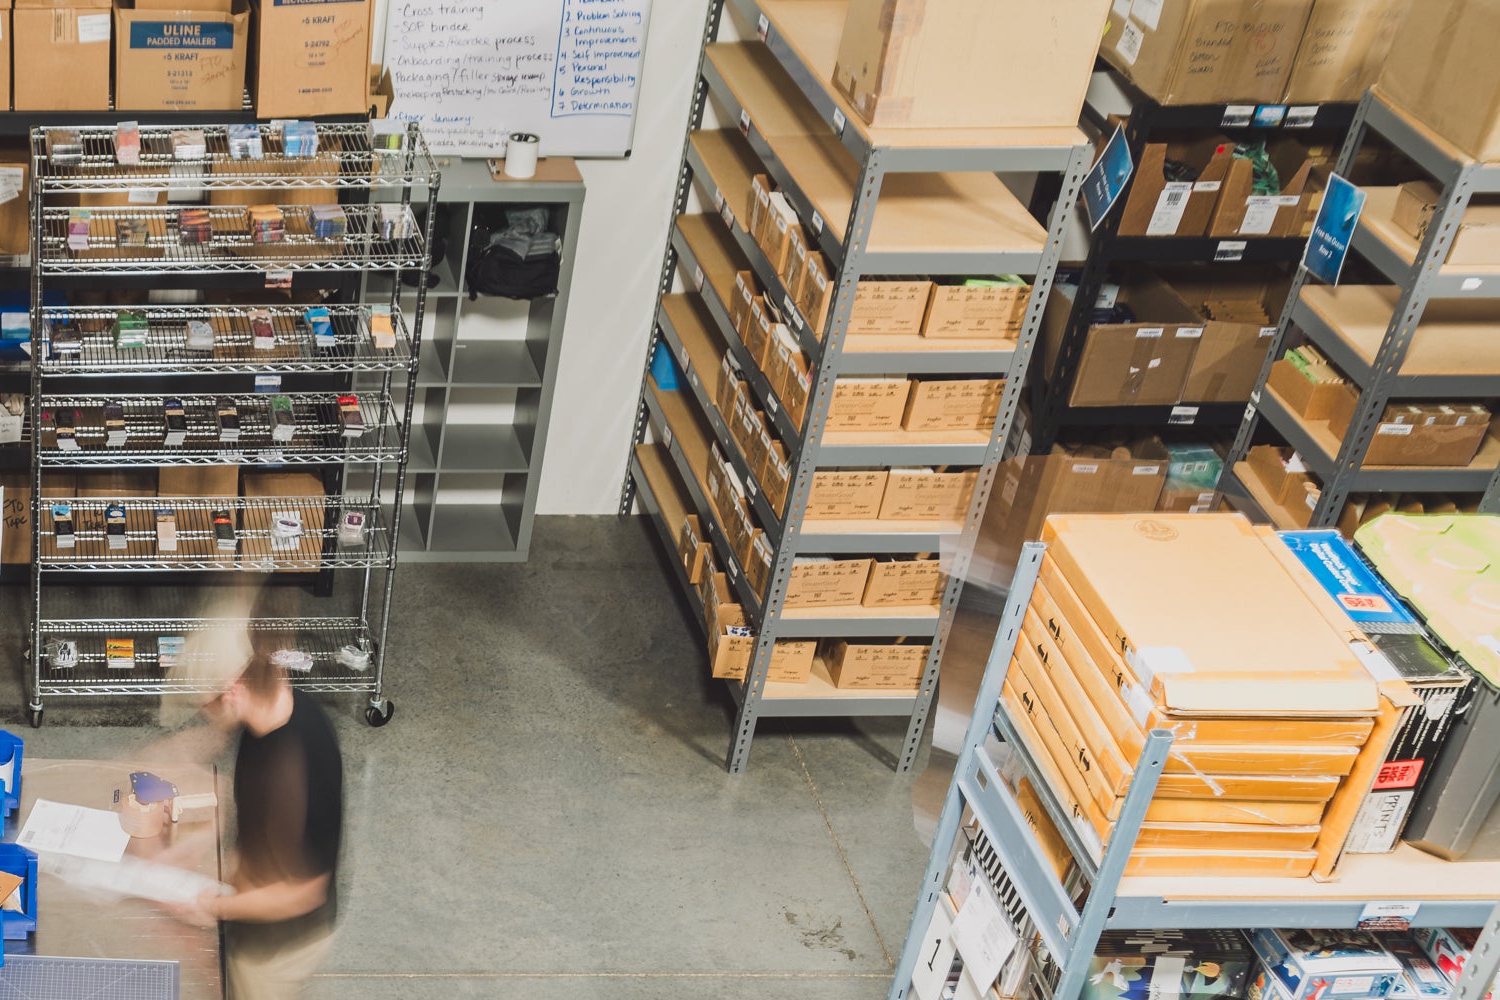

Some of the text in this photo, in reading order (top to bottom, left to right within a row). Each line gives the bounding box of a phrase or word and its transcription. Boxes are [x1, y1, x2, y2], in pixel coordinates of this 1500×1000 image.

[440, 5, 484, 19] training
[577, 10, 610, 21] Problem
[613, 9, 641, 24] Solving
[312, 16, 335, 24] KRAFT
[163, 25, 201, 36] ULINE
[574, 26, 624, 35] Continuous
[147, 37, 216, 46] PADDED MAILERS
[495, 36, 535, 50] process
[576, 36, 637, 48] Improvement
[174, 53, 199, 61] KRAFT
[573, 50, 590, 60] Self
[594, 50, 640, 60] Improvement
[515, 54, 553, 69] process
[574, 74, 636, 88] Responsibility
[570, 87, 610, 96] Growth
[571, 100, 632, 110] Determination
[1315, 226, 1345, 251] Free the Ocean
[1319, 244, 1329, 256] Row
